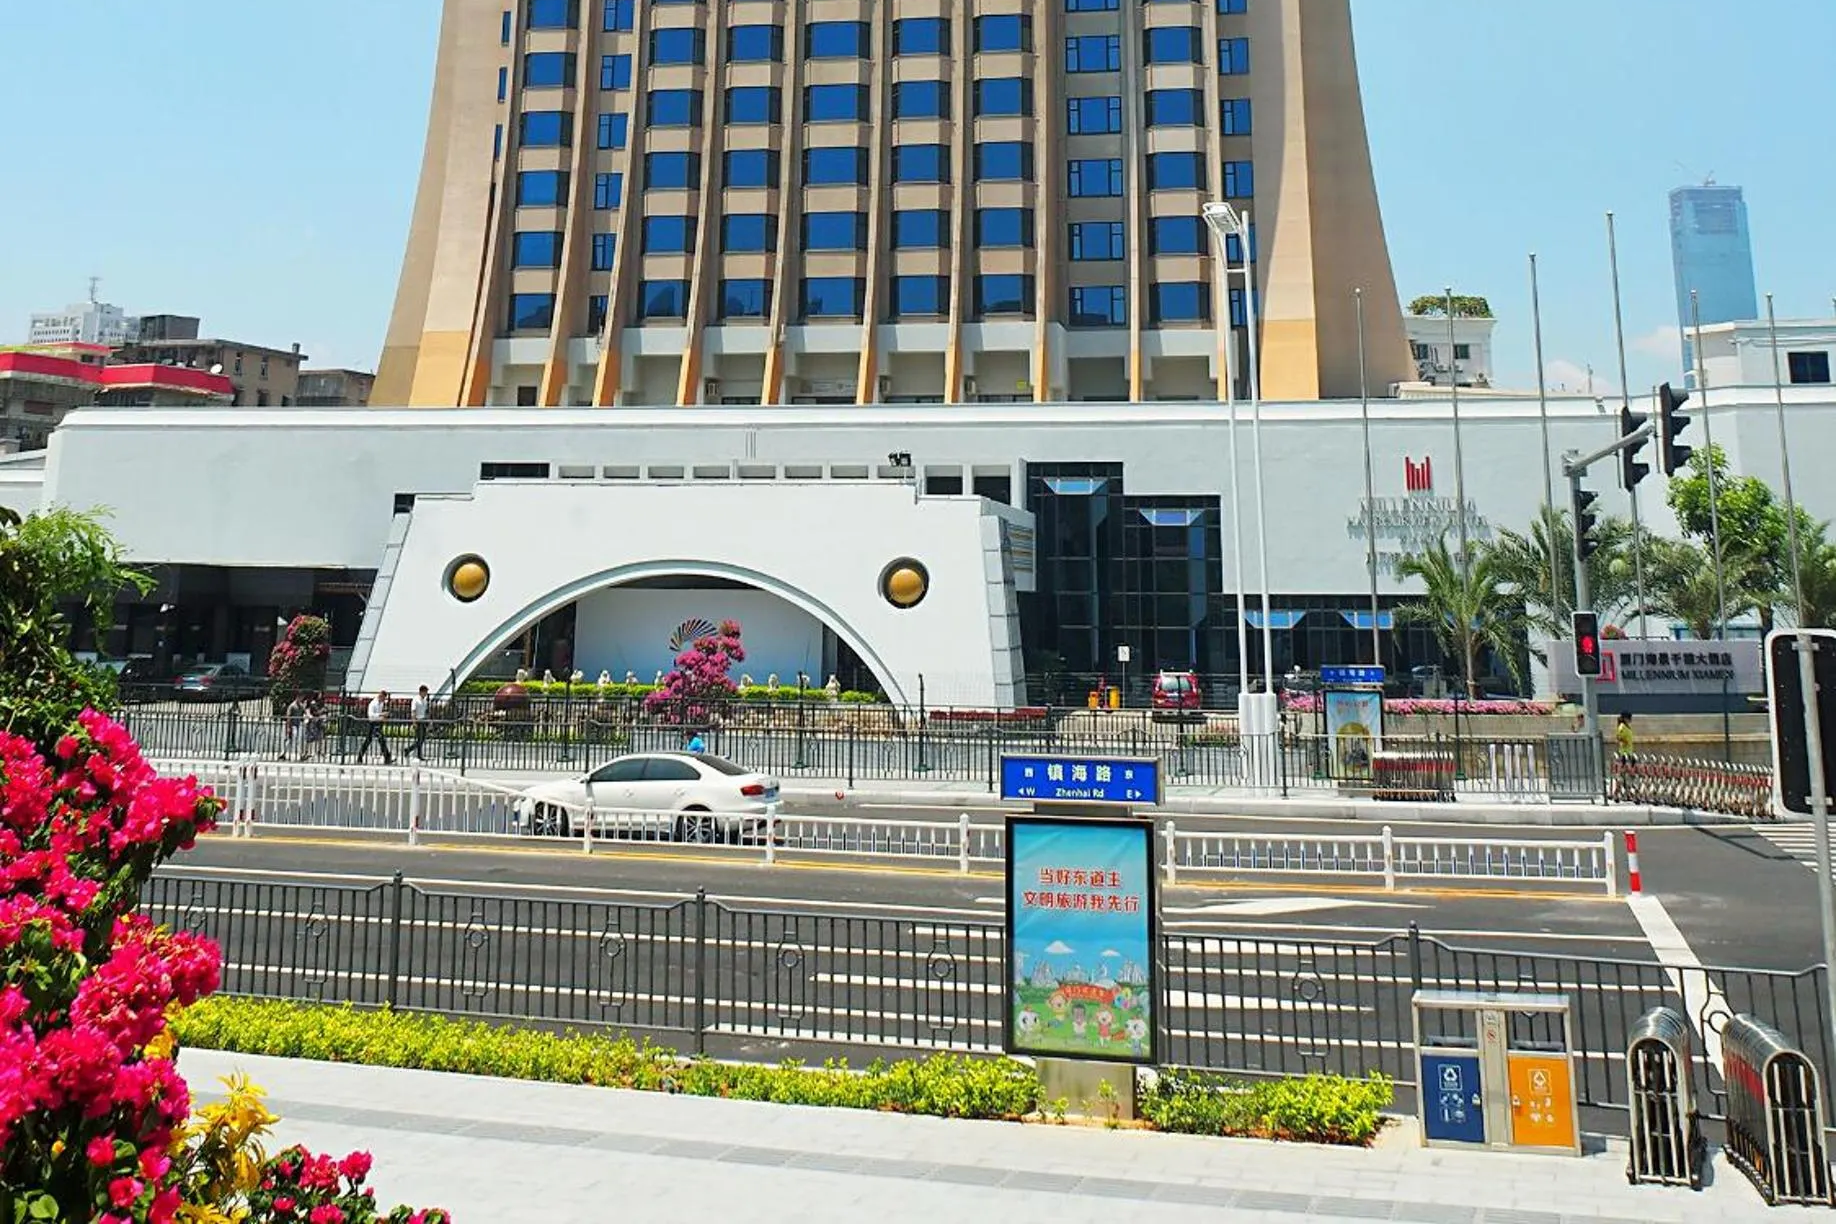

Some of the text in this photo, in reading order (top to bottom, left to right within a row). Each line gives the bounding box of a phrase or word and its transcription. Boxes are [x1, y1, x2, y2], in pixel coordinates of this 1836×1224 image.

[1047, 763, 1112, 783] 镇海路
[1026, 787, 1133, 799] W Zhenhai Rd E
[1040, 867, 1121, 888] 当好东道主
[1023, 890, 1139, 913] 文明旅游我先行
